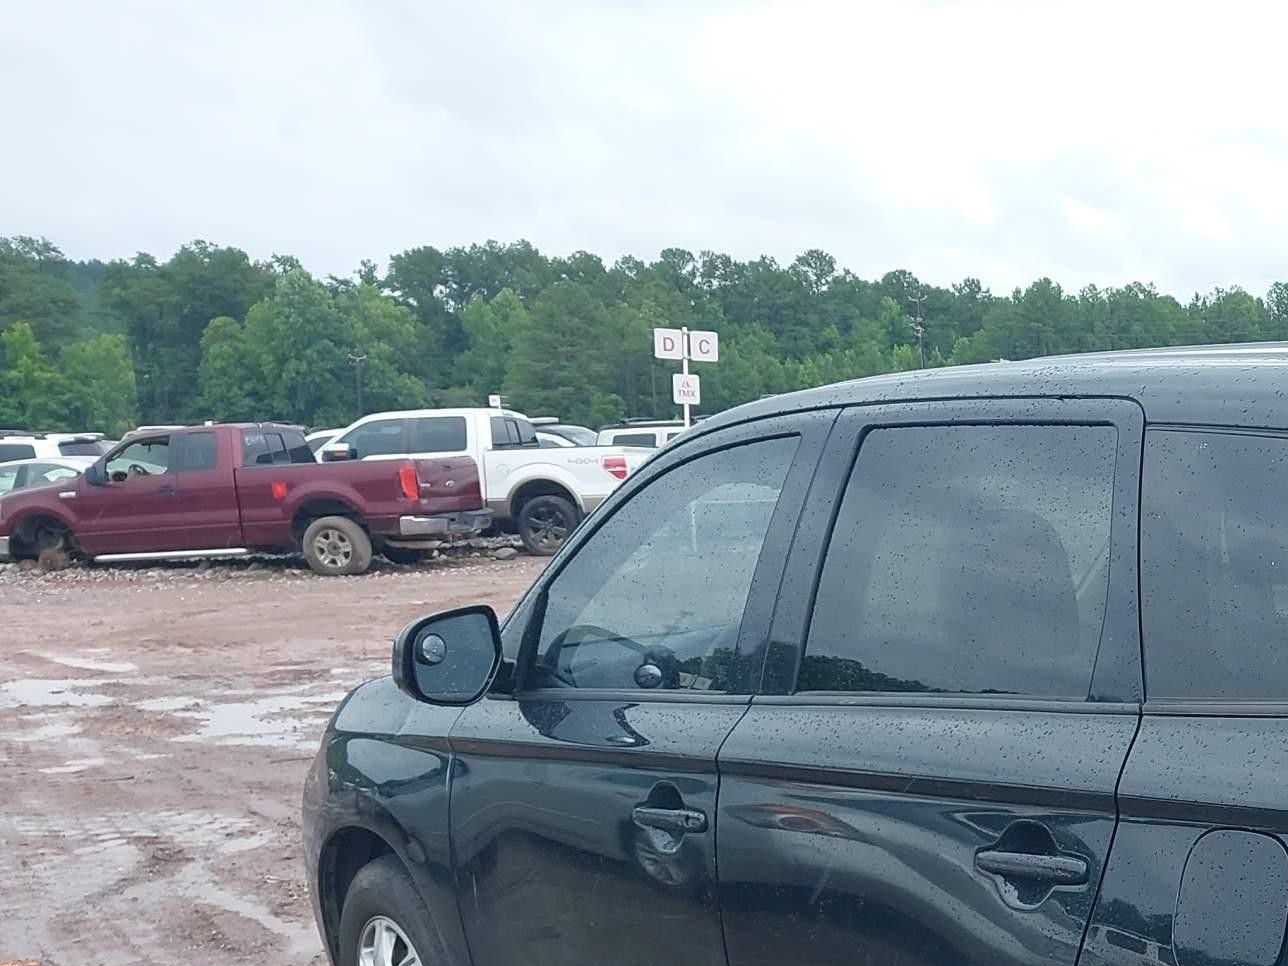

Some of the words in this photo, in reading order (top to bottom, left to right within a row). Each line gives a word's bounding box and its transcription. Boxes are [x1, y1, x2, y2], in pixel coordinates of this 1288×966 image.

[663, 336, 675, 352] D
[699, 339, 710, 354] C
[678, 389, 696, 398] TMX
